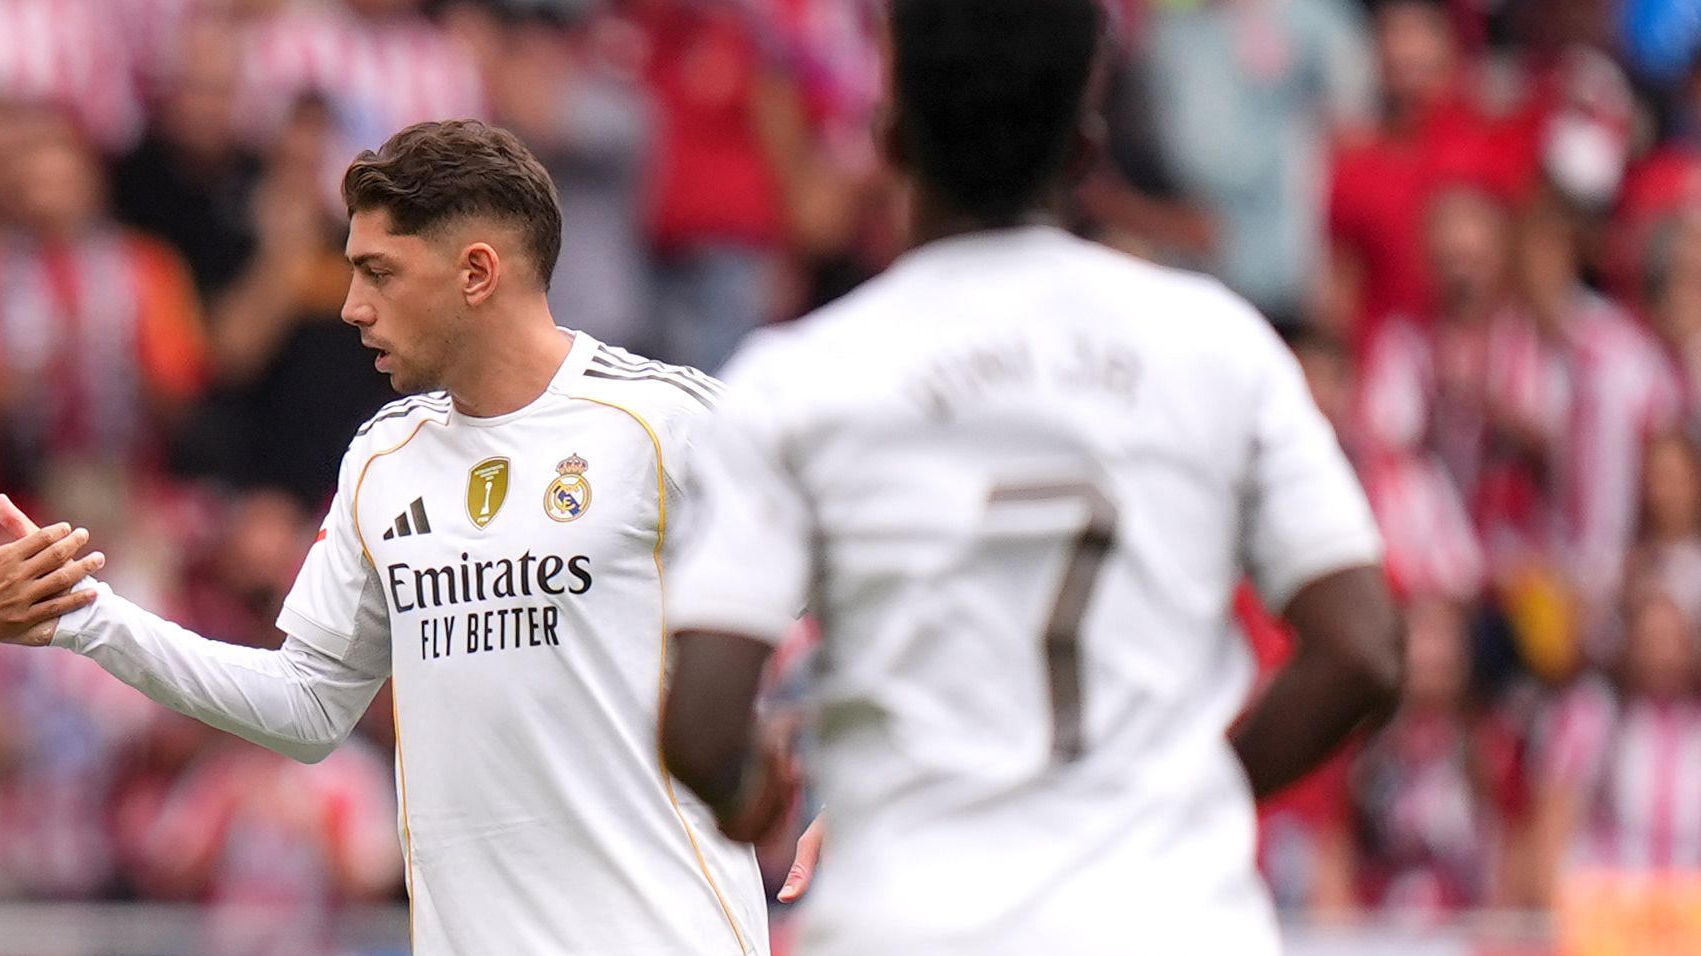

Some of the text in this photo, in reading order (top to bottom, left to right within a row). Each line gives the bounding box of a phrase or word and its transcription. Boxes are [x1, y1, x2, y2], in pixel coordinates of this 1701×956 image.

[388, 550, 593, 614] Emirates
[421, 606, 560, 660] FLY BETTER
[986, 480, 1119, 763] 7
